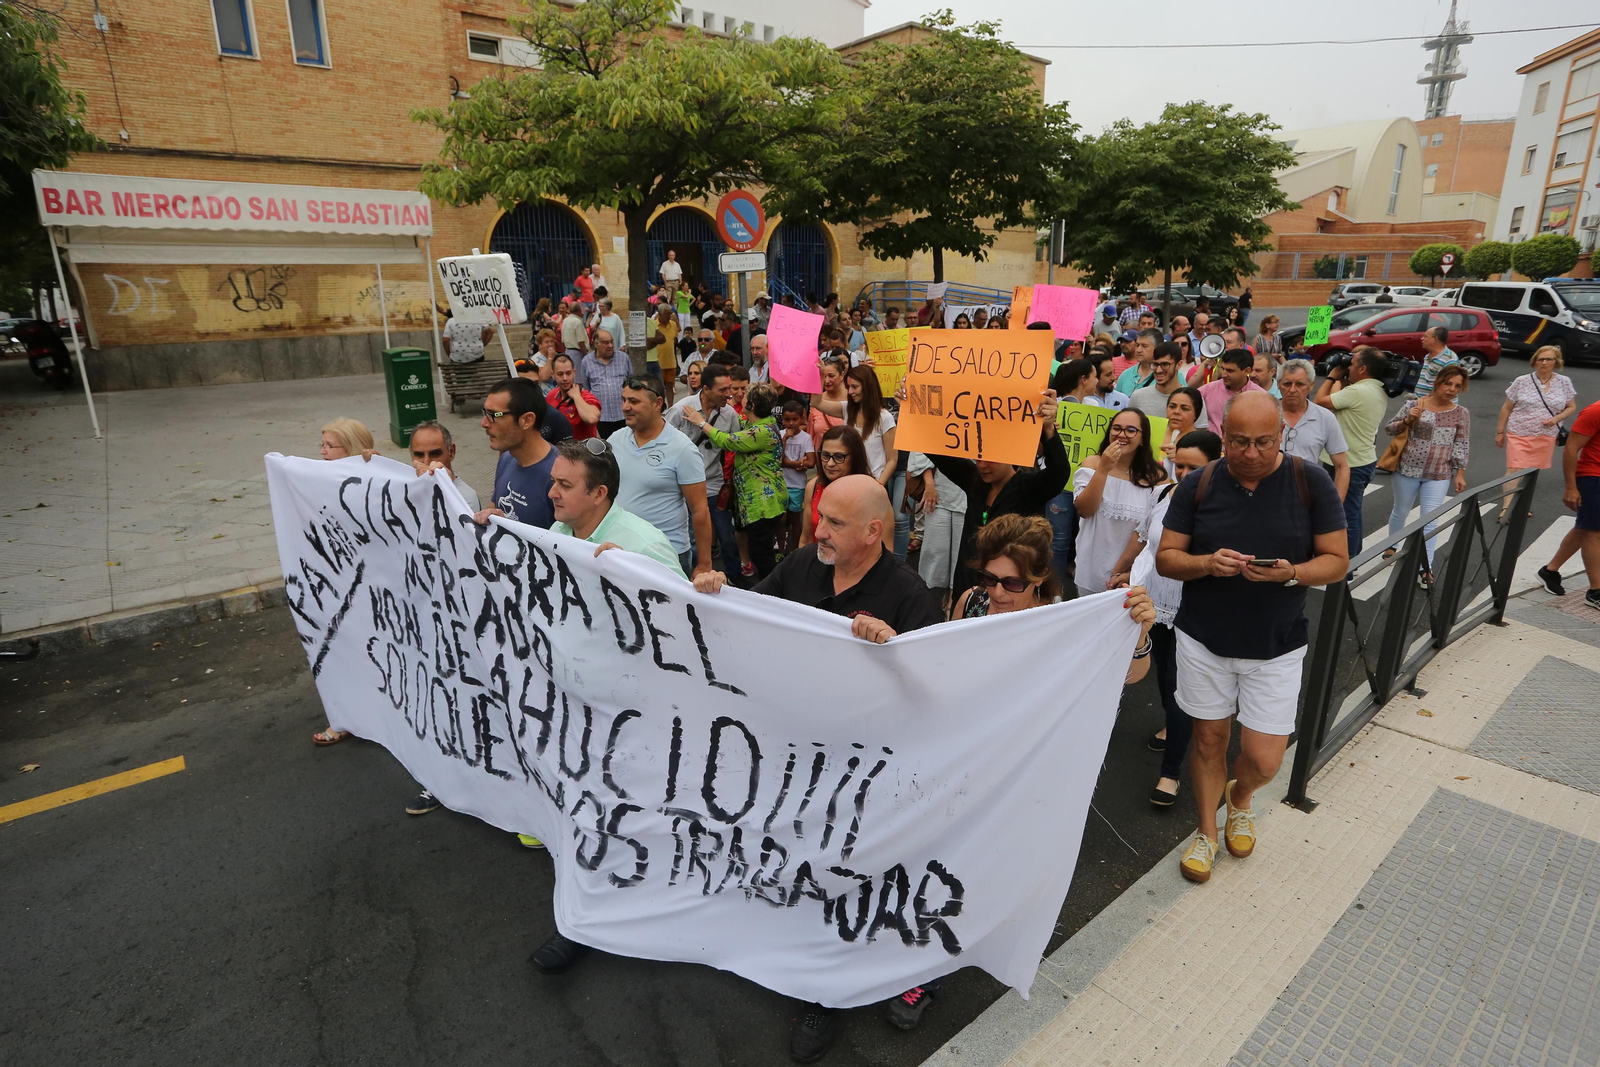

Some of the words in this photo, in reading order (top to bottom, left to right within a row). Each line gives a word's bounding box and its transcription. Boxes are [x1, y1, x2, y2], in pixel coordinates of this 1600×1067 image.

[42, 187, 106, 216] BAR
[111, 191, 242, 221] MERCADO
[248, 196, 299, 222] SAN
[306, 199, 429, 226] SEBASTIAN
[884, 354, 908, 363] CARP
[401, 383, 428, 391] CORREOS
[953, 391, 1036, 425] CARPA
[600, 575, 747, 697] DEL
